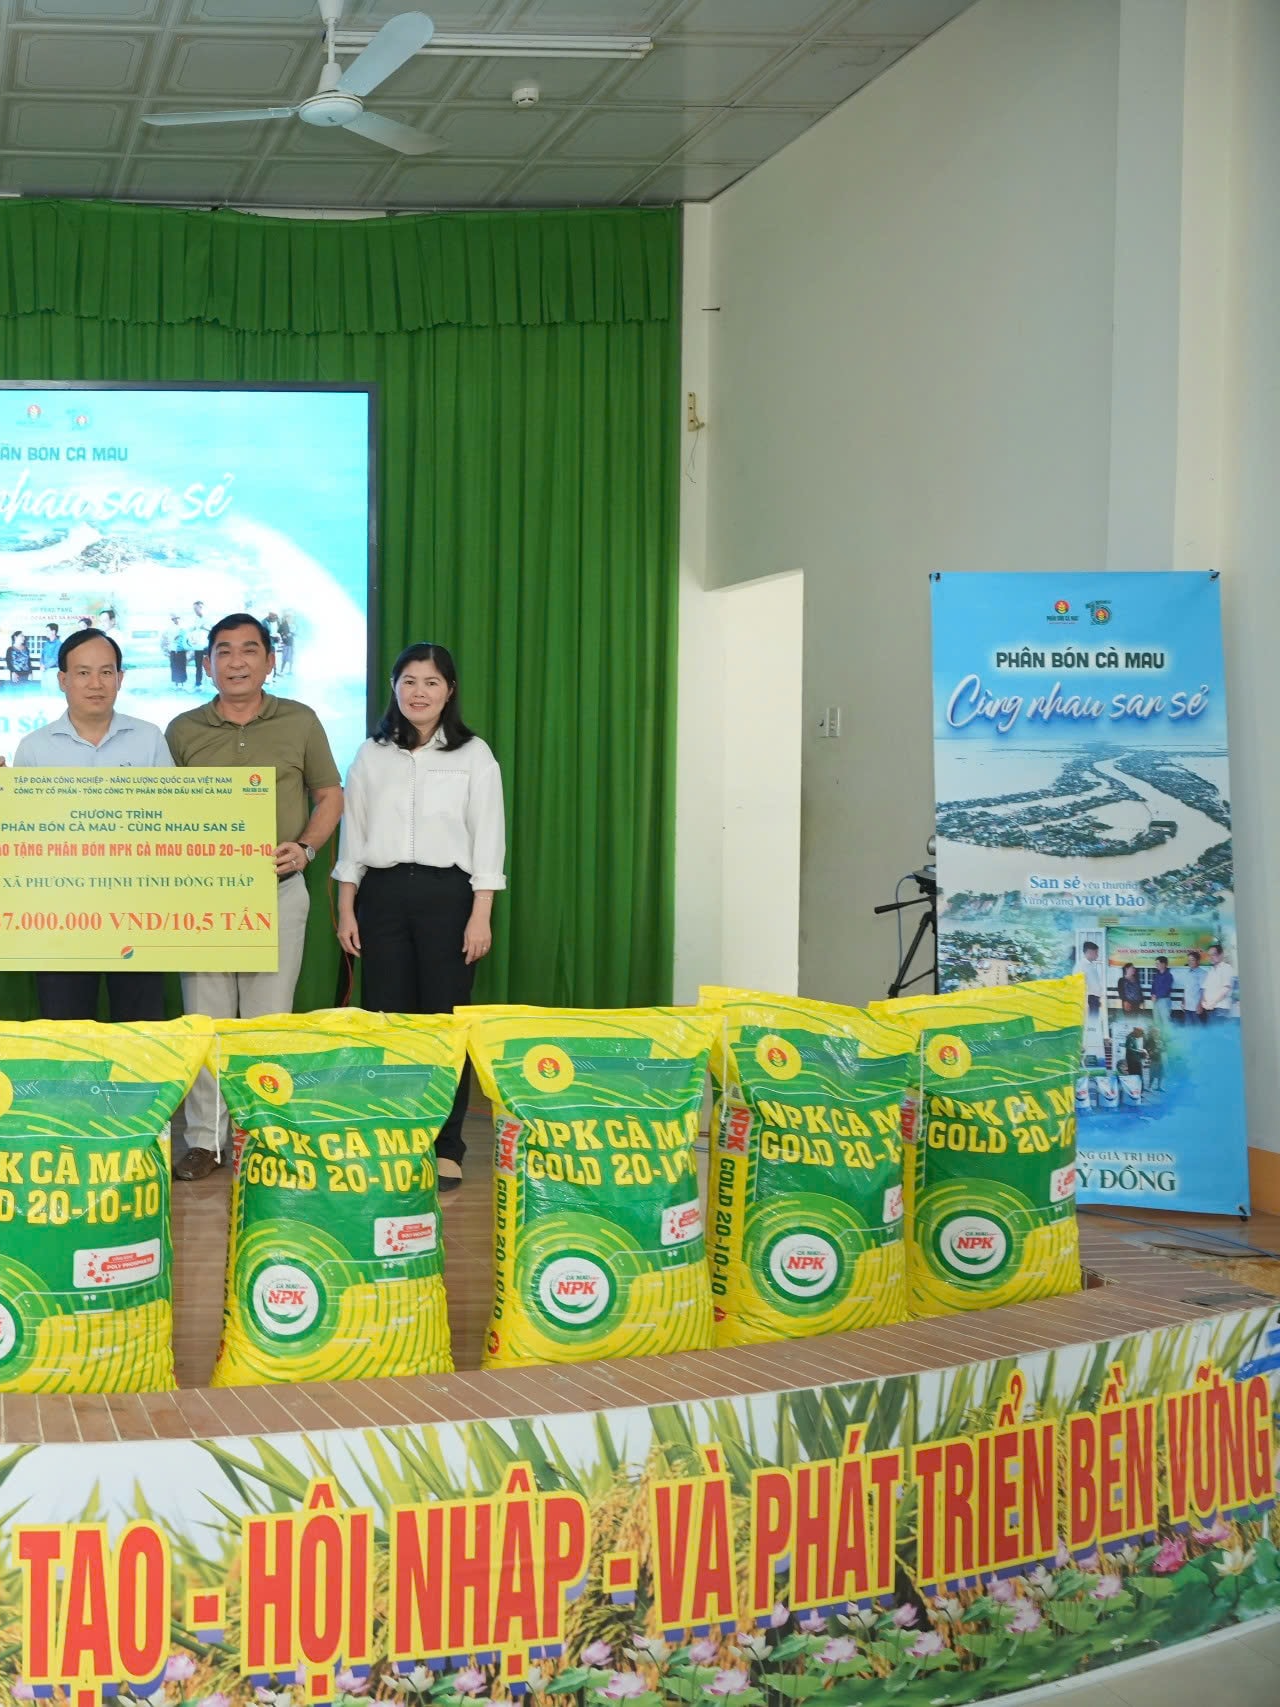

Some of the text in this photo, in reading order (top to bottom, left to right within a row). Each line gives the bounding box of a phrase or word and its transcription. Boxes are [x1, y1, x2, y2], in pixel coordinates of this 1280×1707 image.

[92, 446, 128, 461] MAU
[996, 646, 1165, 669] PHÂN BÓN CÀ MAU
[946, 673, 1210, 733] Cùng nhau san sẻ
[0, 821, 36, 832] PHÂN
[38, 821, 65, 832] BÓN
[68, 821, 86, 832] CÀ
[88, 823, 116, 832] MAU
[127, 821, 162, 832] CÙNG
[165, 823, 200, 832] NHAU
[203, 823, 228, 832] SAN
[70, 808, 163, 819] CHƯƠNG TRÌNH
[47, 841, 78, 857] PHÂN
[81, 841, 106, 857] BÓN
[108, 843, 133, 857] NPK
[136, 841, 152, 857] CÀ
[155, 843, 183, 857] MAU
[186, 843, 216, 857] GOLD
[218, 843, 273, 857] 20-10-10
[88, 877, 133, 890] THỊNH
[1029, 875, 1059, 889] San
[1063, 875, 1081, 889] sẻ
[1074, 894, 1112, 908] vượt
[1115, 893, 1146, 907] bão
[108, 912, 214, 933] VND/10,5
[220, 906, 272, 931] TẤN
[757, 1099, 832, 1134] NPK
[830, 1106, 873, 1137] CÀ
[1003, 1090, 1049, 1124] CÀ
[318, 1126, 372, 1162] CÀ
[499, 1121, 522, 1172] NPK
[524, 1118, 604, 1151] NPK
[604, 1114, 652, 1150] CÀ
[726, 1106, 751, 1153] NPK
[928, 1121, 1008, 1154] GOLD
[29, 1143, 80, 1186] CÀ
[88, 1147, 157, 1185] MAU
[760, 1130, 835, 1168] GOLD
[247, 1152, 317, 1191] GOLD
[526, 1149, 603, 1186] GOLD
[718, 1157, 736, 1207] GOLD
[1076, 1162, 1177, 1192] Ỷ ĐỒNG
[27, 1181, 160, 1225] 20-10-10
[496, 1178, 509, 1230] GOLD
[711, 1210, 732, 1297] 20-10-10
[956, 1236, 996, 1249] NPK
[786, 1256, 827, 1270] NPK
[268, 1289, 306, 1305] NPK
[556, 1281, 597, 1295] NPK
[18, 1525, 166, 1707] TẠO
[248, 1482, 369, 1696] HỘI
[394, 1467, 587, 1676] NHẬP
[655, 1449, 734, 1624] VÀ
[754, 1429, 901, 1611] PHÁT
[916, 1373, 1056, 1581] TRIỂN
[1071, 1362, 1156, 1548] BỀN
[1166, 1364, 1274, 1523] VỮNG
